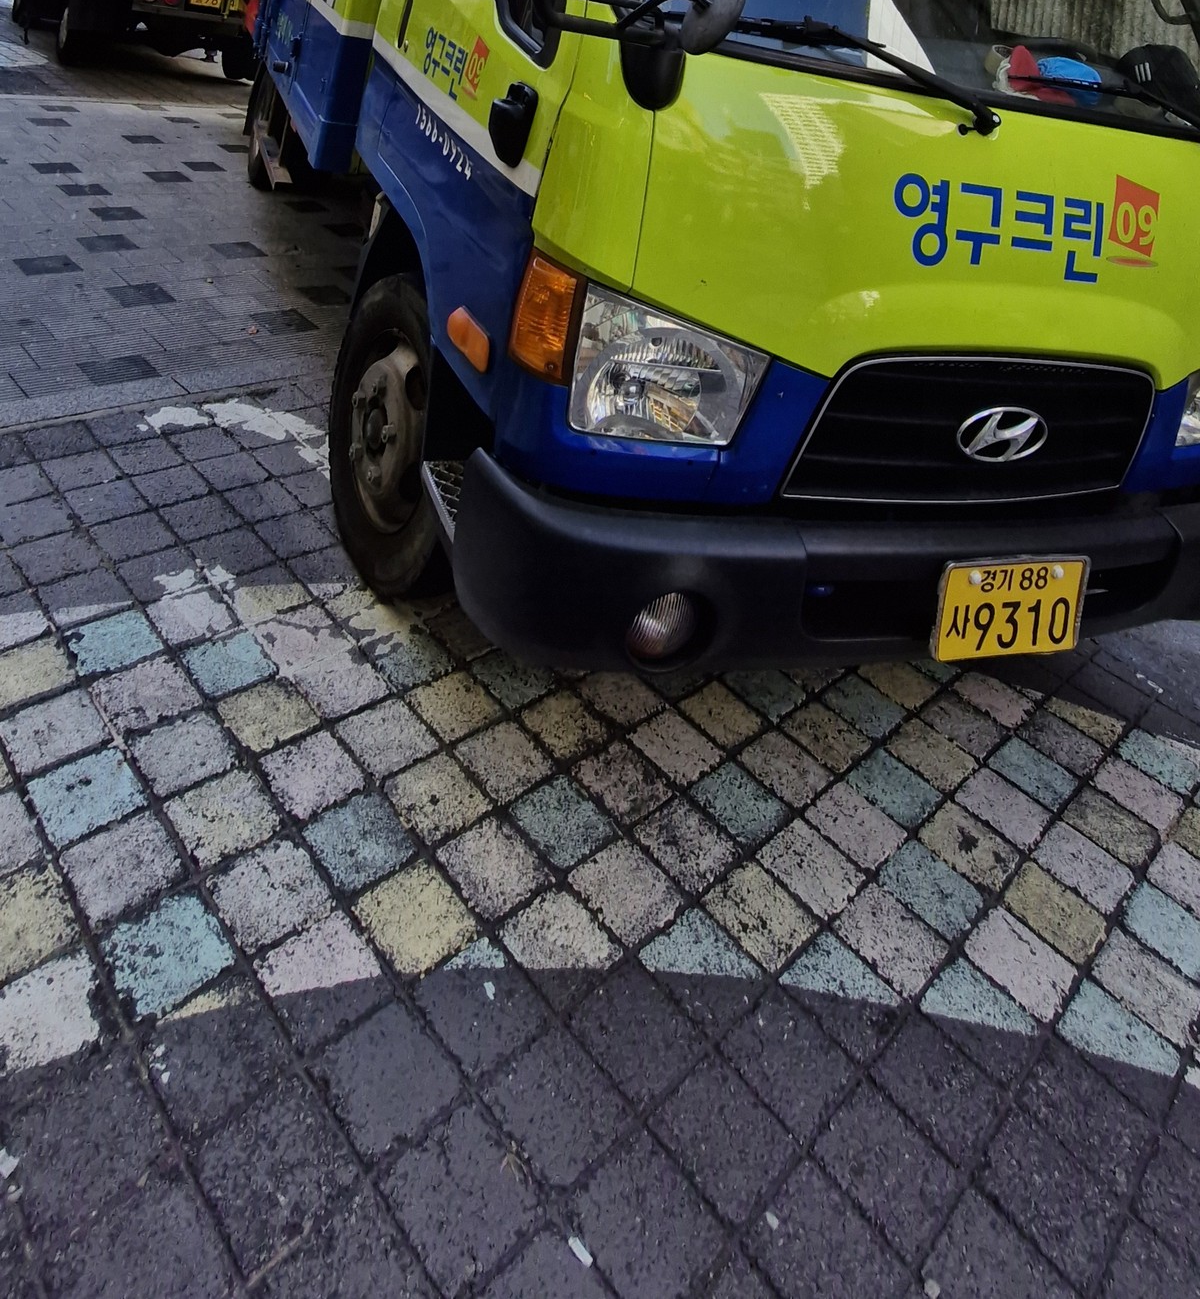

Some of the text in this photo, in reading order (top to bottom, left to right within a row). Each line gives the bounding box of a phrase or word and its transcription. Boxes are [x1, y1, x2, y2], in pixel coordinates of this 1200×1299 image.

[423, 26, 468, 101] 영구크린
[415, 103, 474, 181] 1566-0924
[894, 172, 1159, 284] 영구크린 09
[981, 566, 1049, 593] 경기 88
[945, 596, 1071, 652] 사9310
